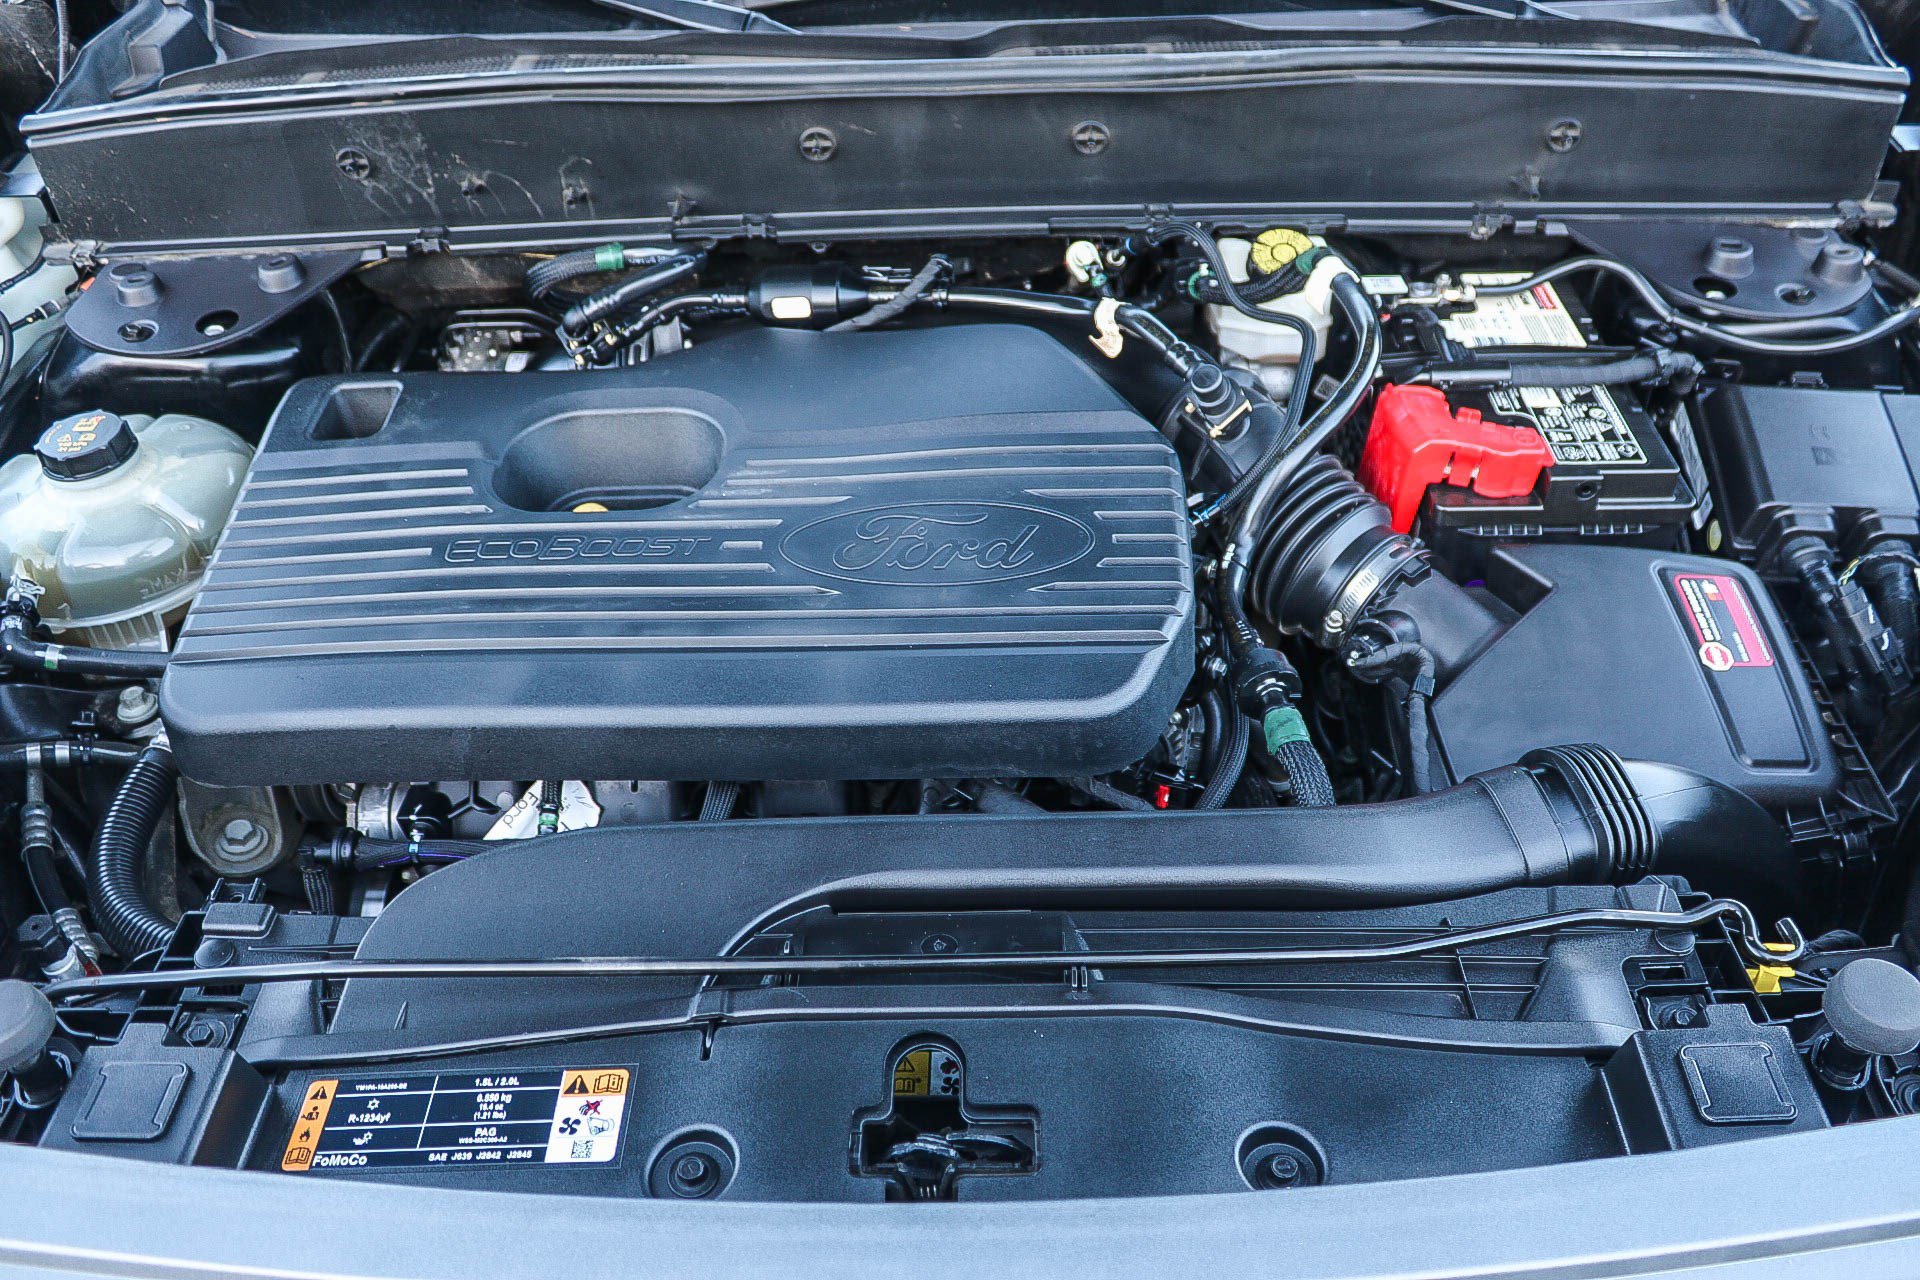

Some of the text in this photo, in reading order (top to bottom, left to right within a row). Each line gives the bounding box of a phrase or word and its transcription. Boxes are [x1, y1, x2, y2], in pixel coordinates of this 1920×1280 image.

[833, 513, 1040, 571] Ford
[502, 791, 539, 829] Ford
[500, 1076, 520, 1086] 2.0L
[500, 1093, 512, 1104] kg
[348, 1112, 391, 1124] R-1234yf
[474, 1127, 497, 1137] PAG
[312, 1153, 368, 1167] FoMoCo
[428, 1152, 448, 1162] SAE
[451, 1151, 473, 1161] J639
